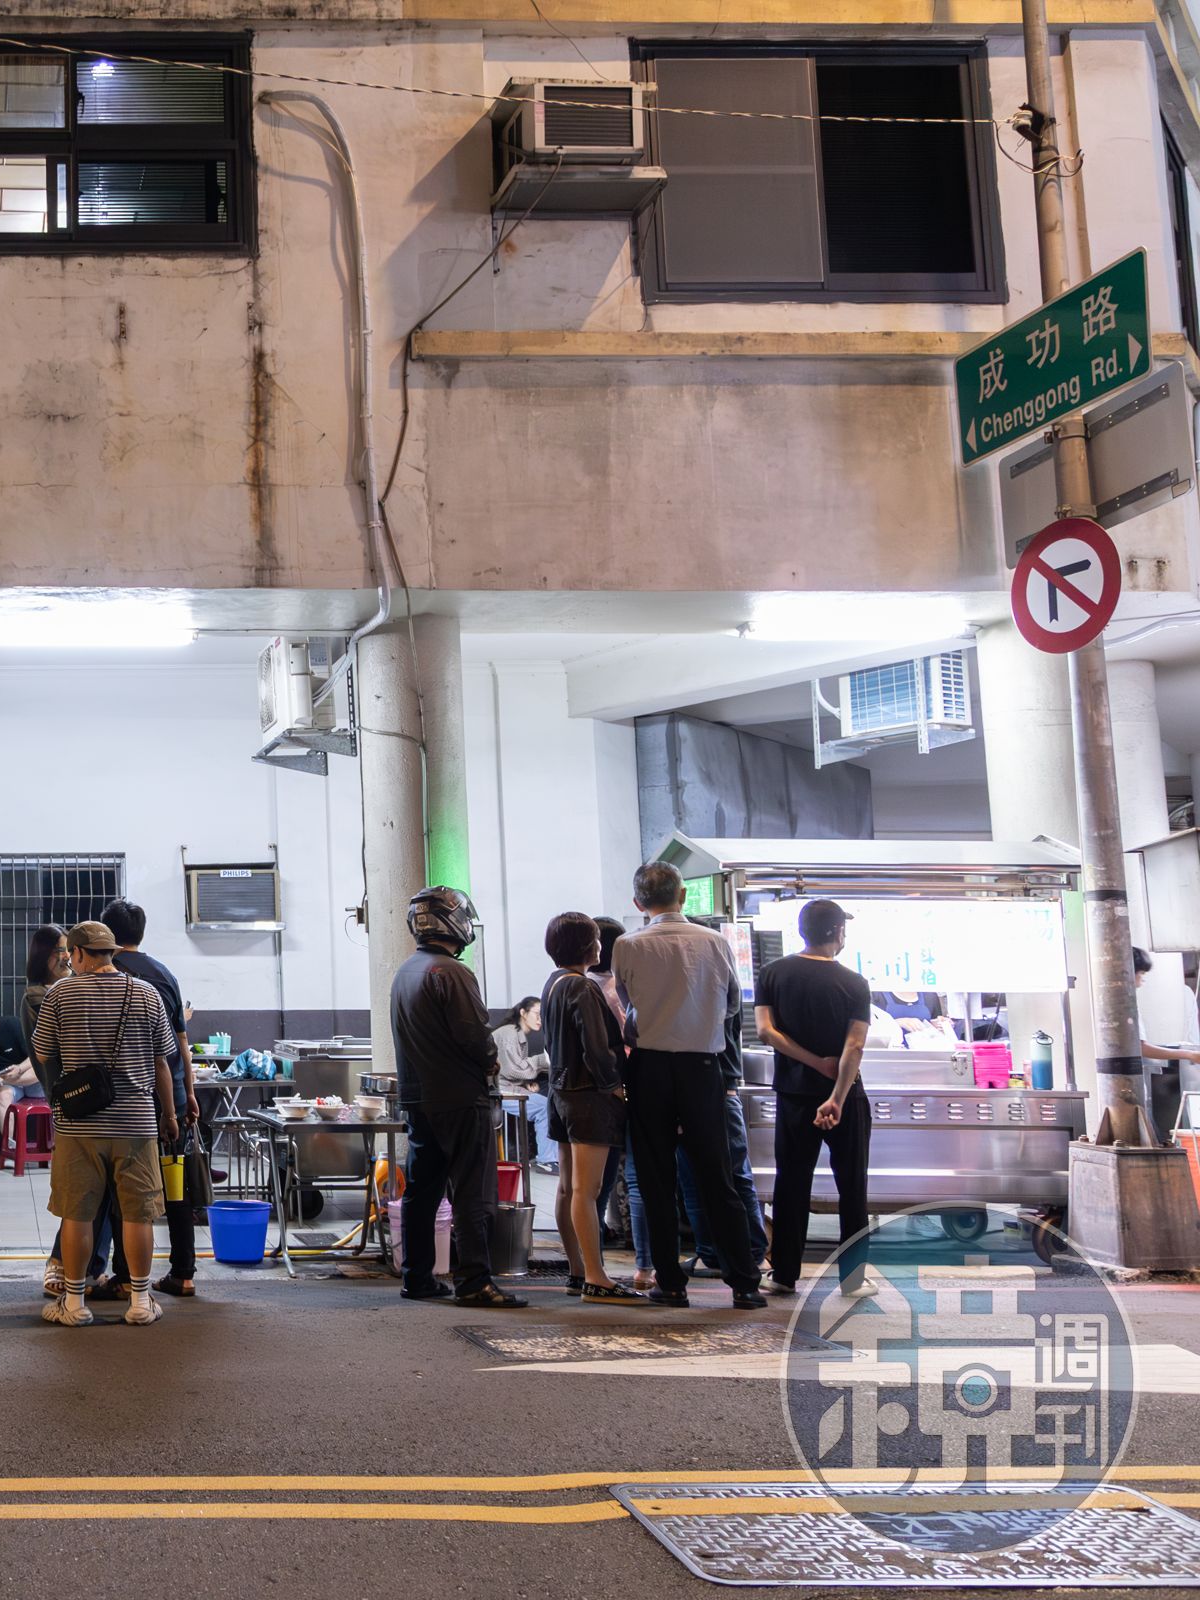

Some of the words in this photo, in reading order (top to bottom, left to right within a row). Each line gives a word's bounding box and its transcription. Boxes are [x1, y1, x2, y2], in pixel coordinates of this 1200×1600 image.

[979, 285, 1119, 403] 成功路
[980, 375, 1081, 442] Chenggong
[1091, 348, 1124, 386] Rd.
[933, 1564, 968, 1575] OF
